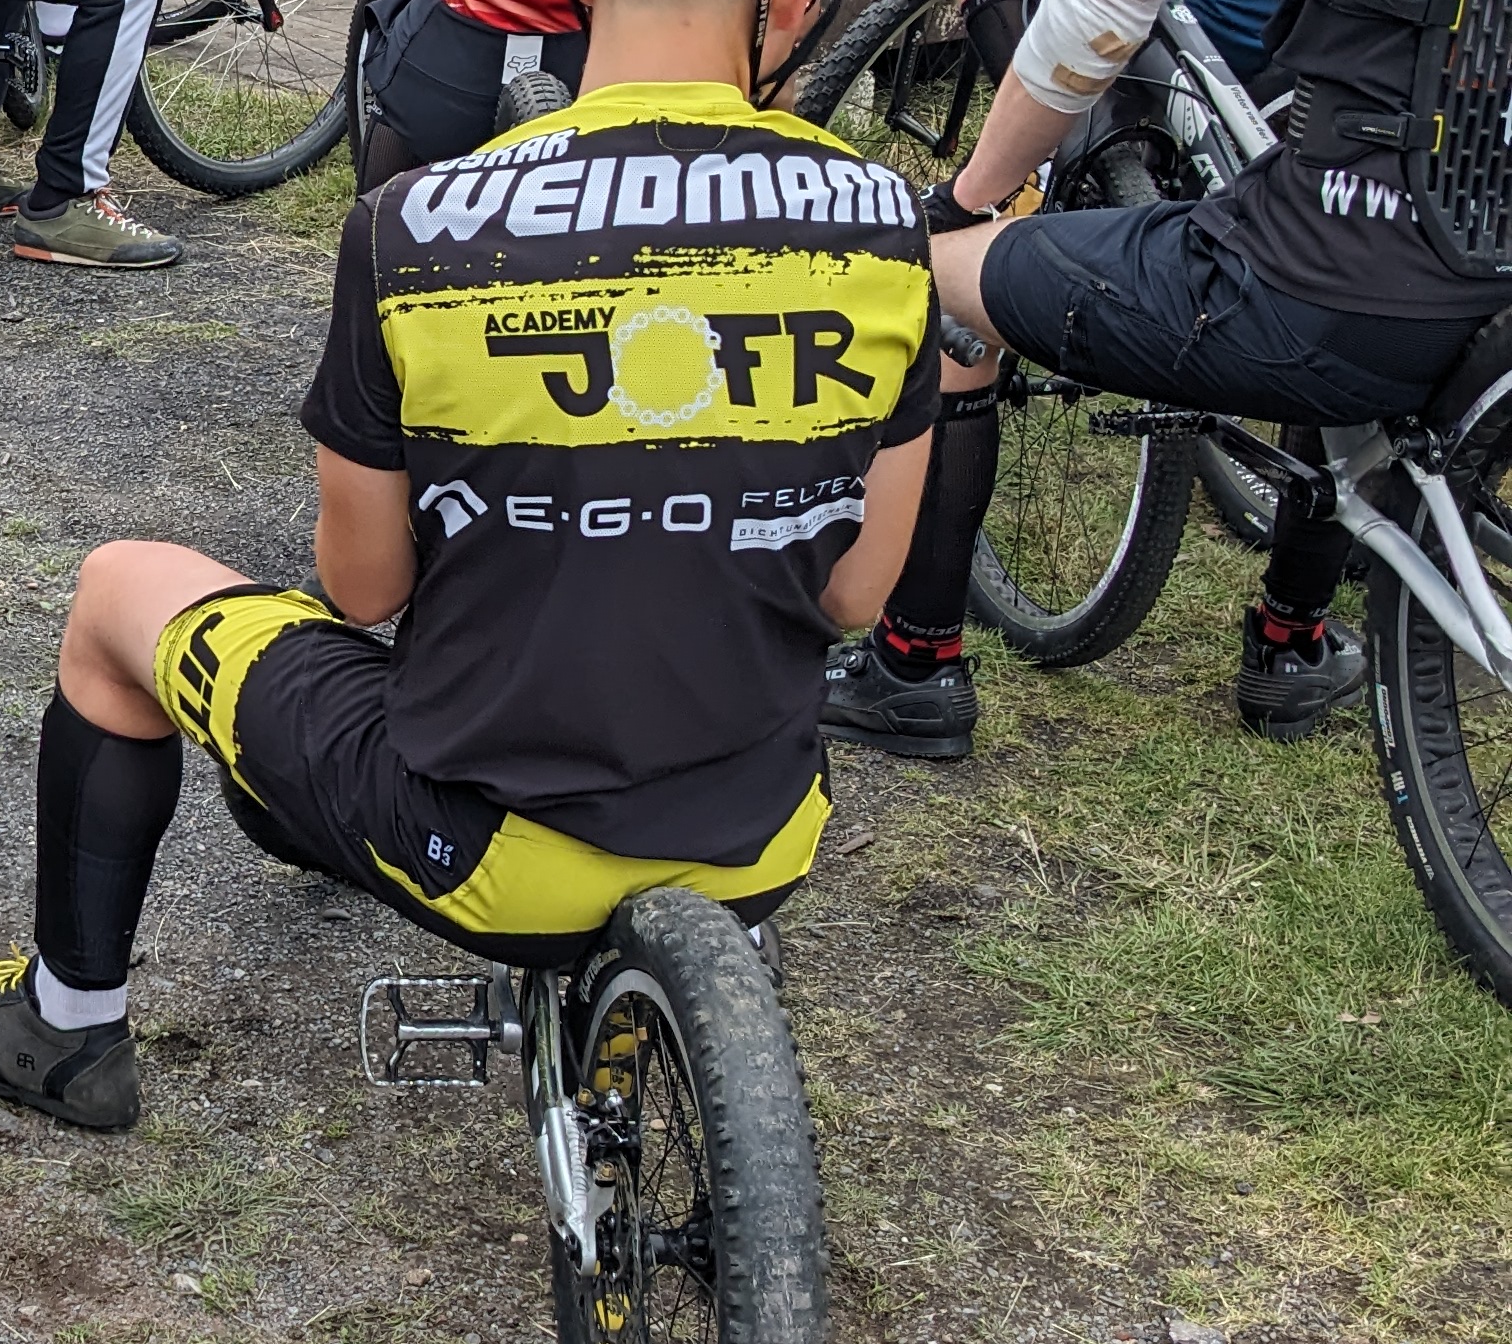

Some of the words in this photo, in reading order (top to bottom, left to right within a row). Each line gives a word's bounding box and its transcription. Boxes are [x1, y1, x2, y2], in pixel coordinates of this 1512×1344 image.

[429, 128, 577, 173] OSKAR
[400, 152, 916, 244] WEIDMANN
[484, 306, 616, 335] ACADEMY
